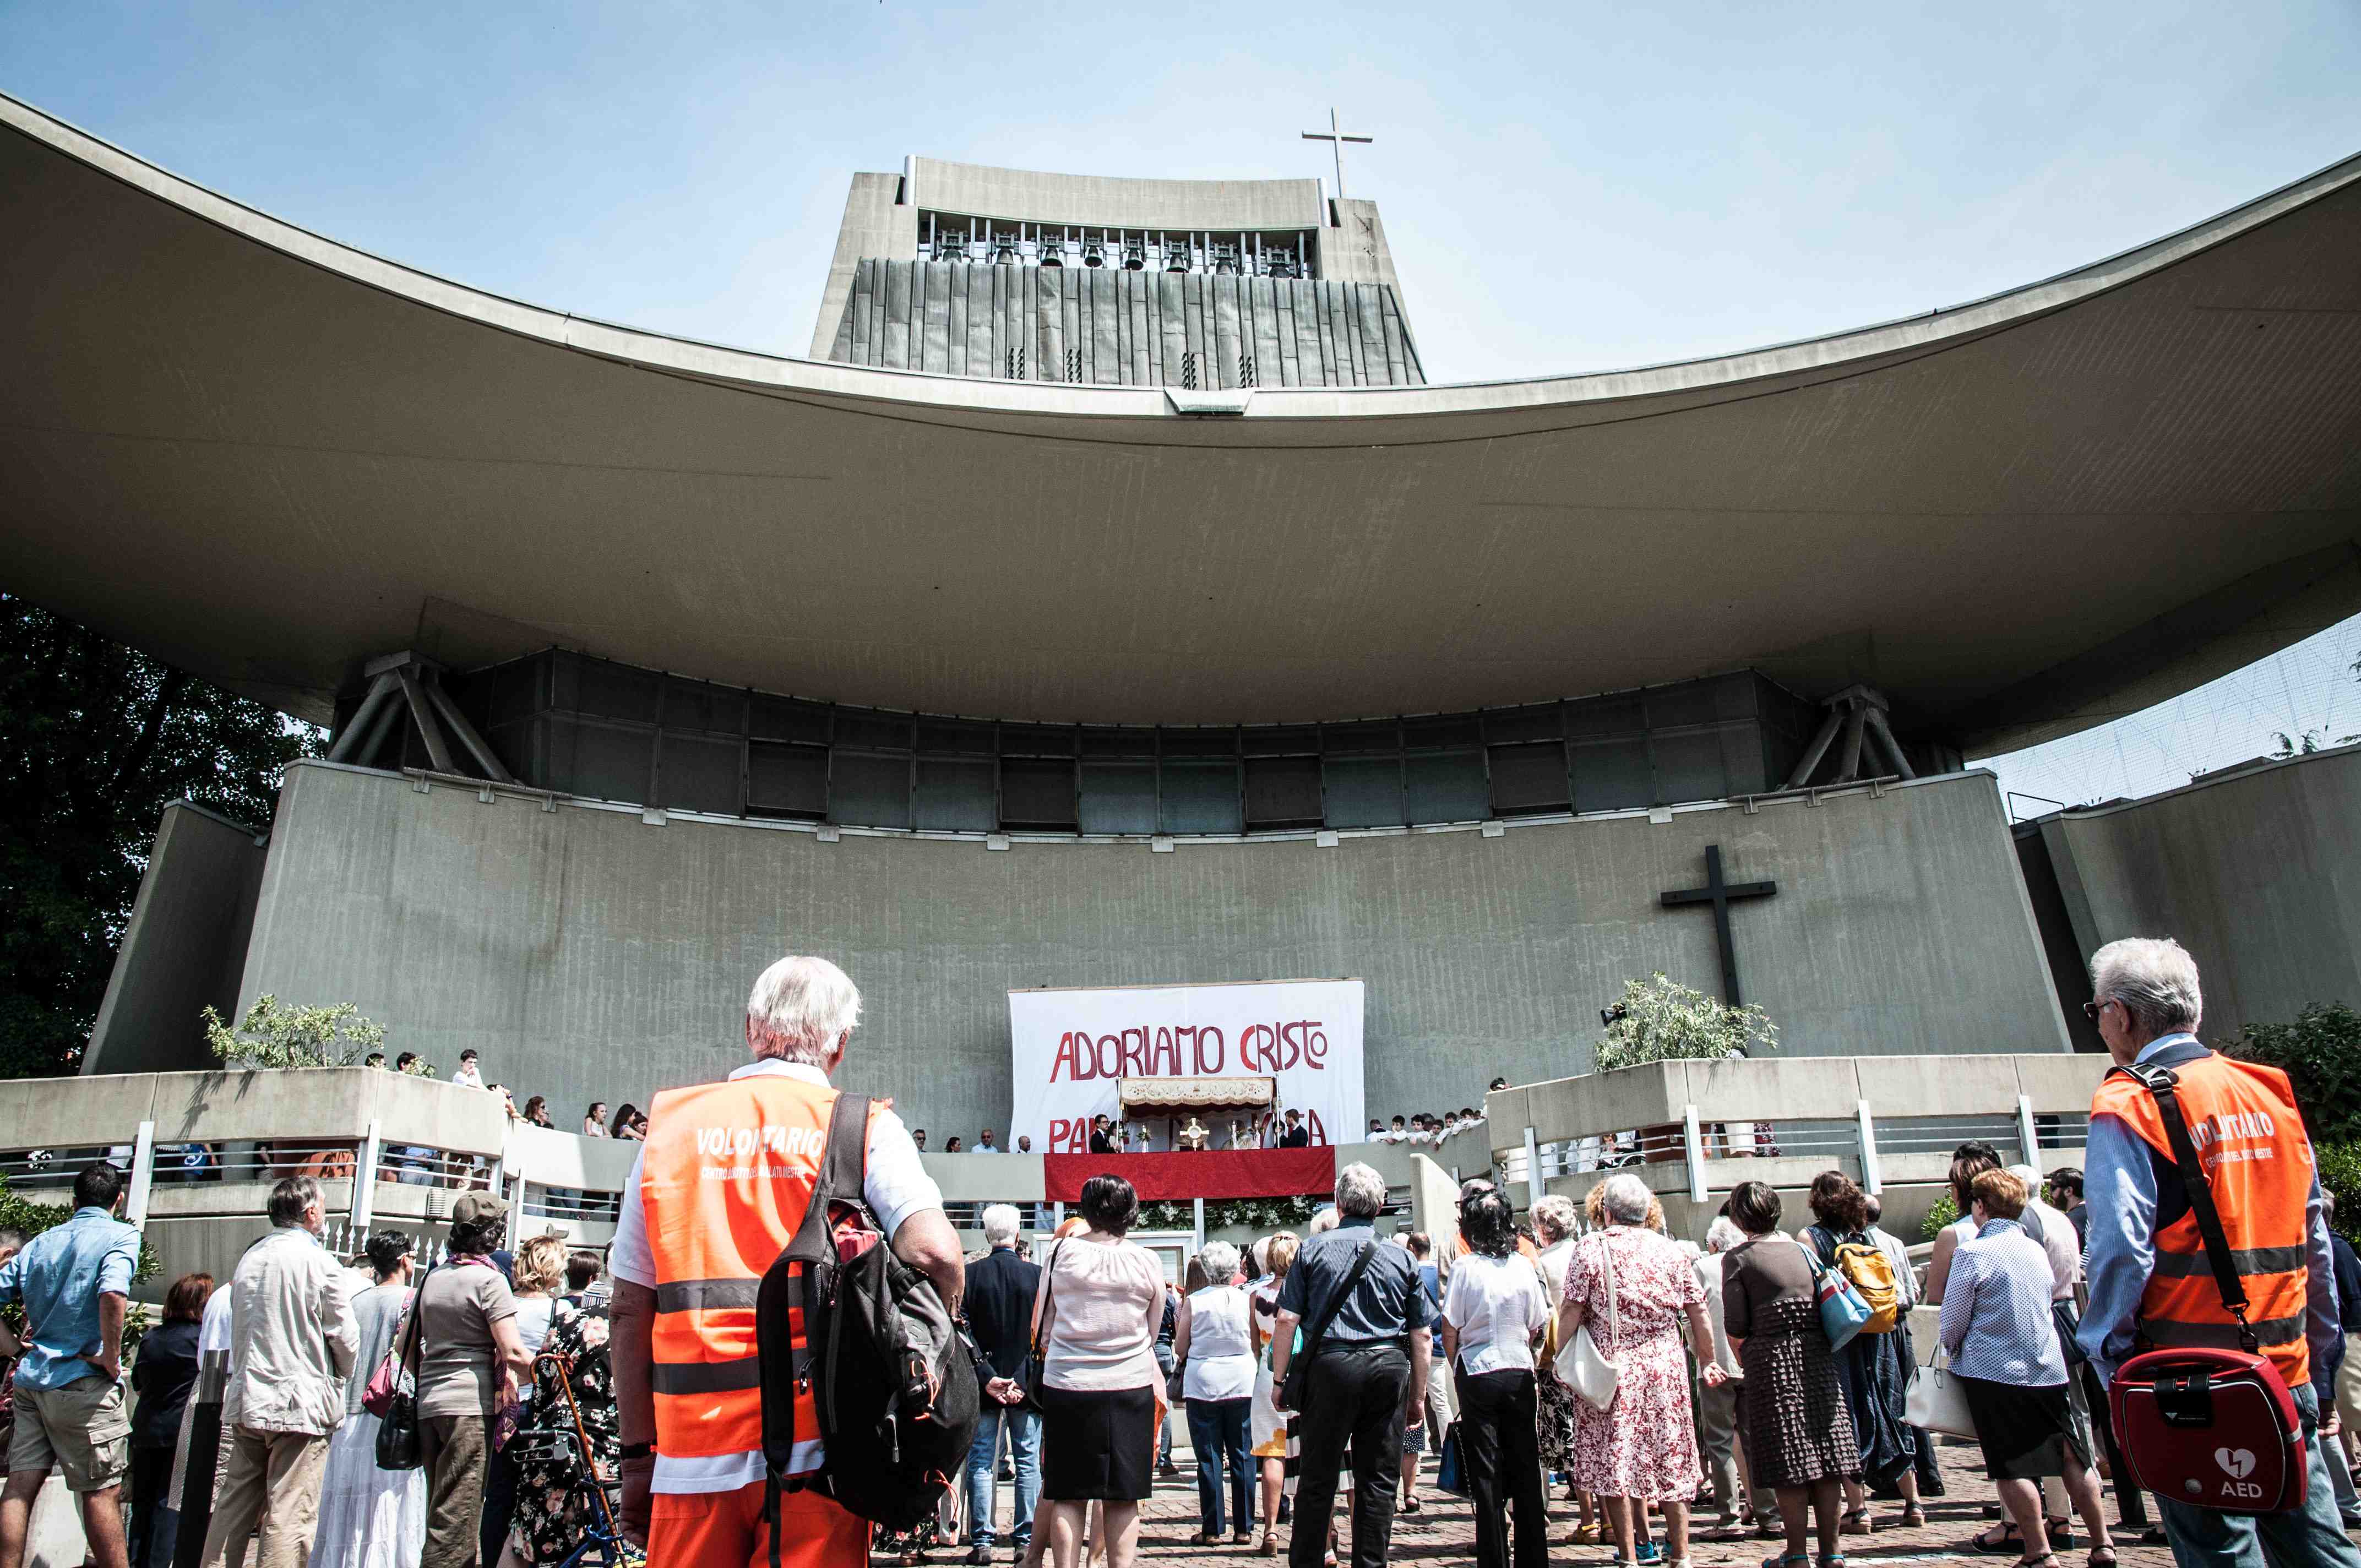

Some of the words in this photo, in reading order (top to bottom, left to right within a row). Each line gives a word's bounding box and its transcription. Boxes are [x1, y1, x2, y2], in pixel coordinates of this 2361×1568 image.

[1049, 1026, 1225, 1082] ADORIAMO
[1240, 1020, 1328, 1072] CRISTO
[2221, 1482, 2262, 1498] AED
